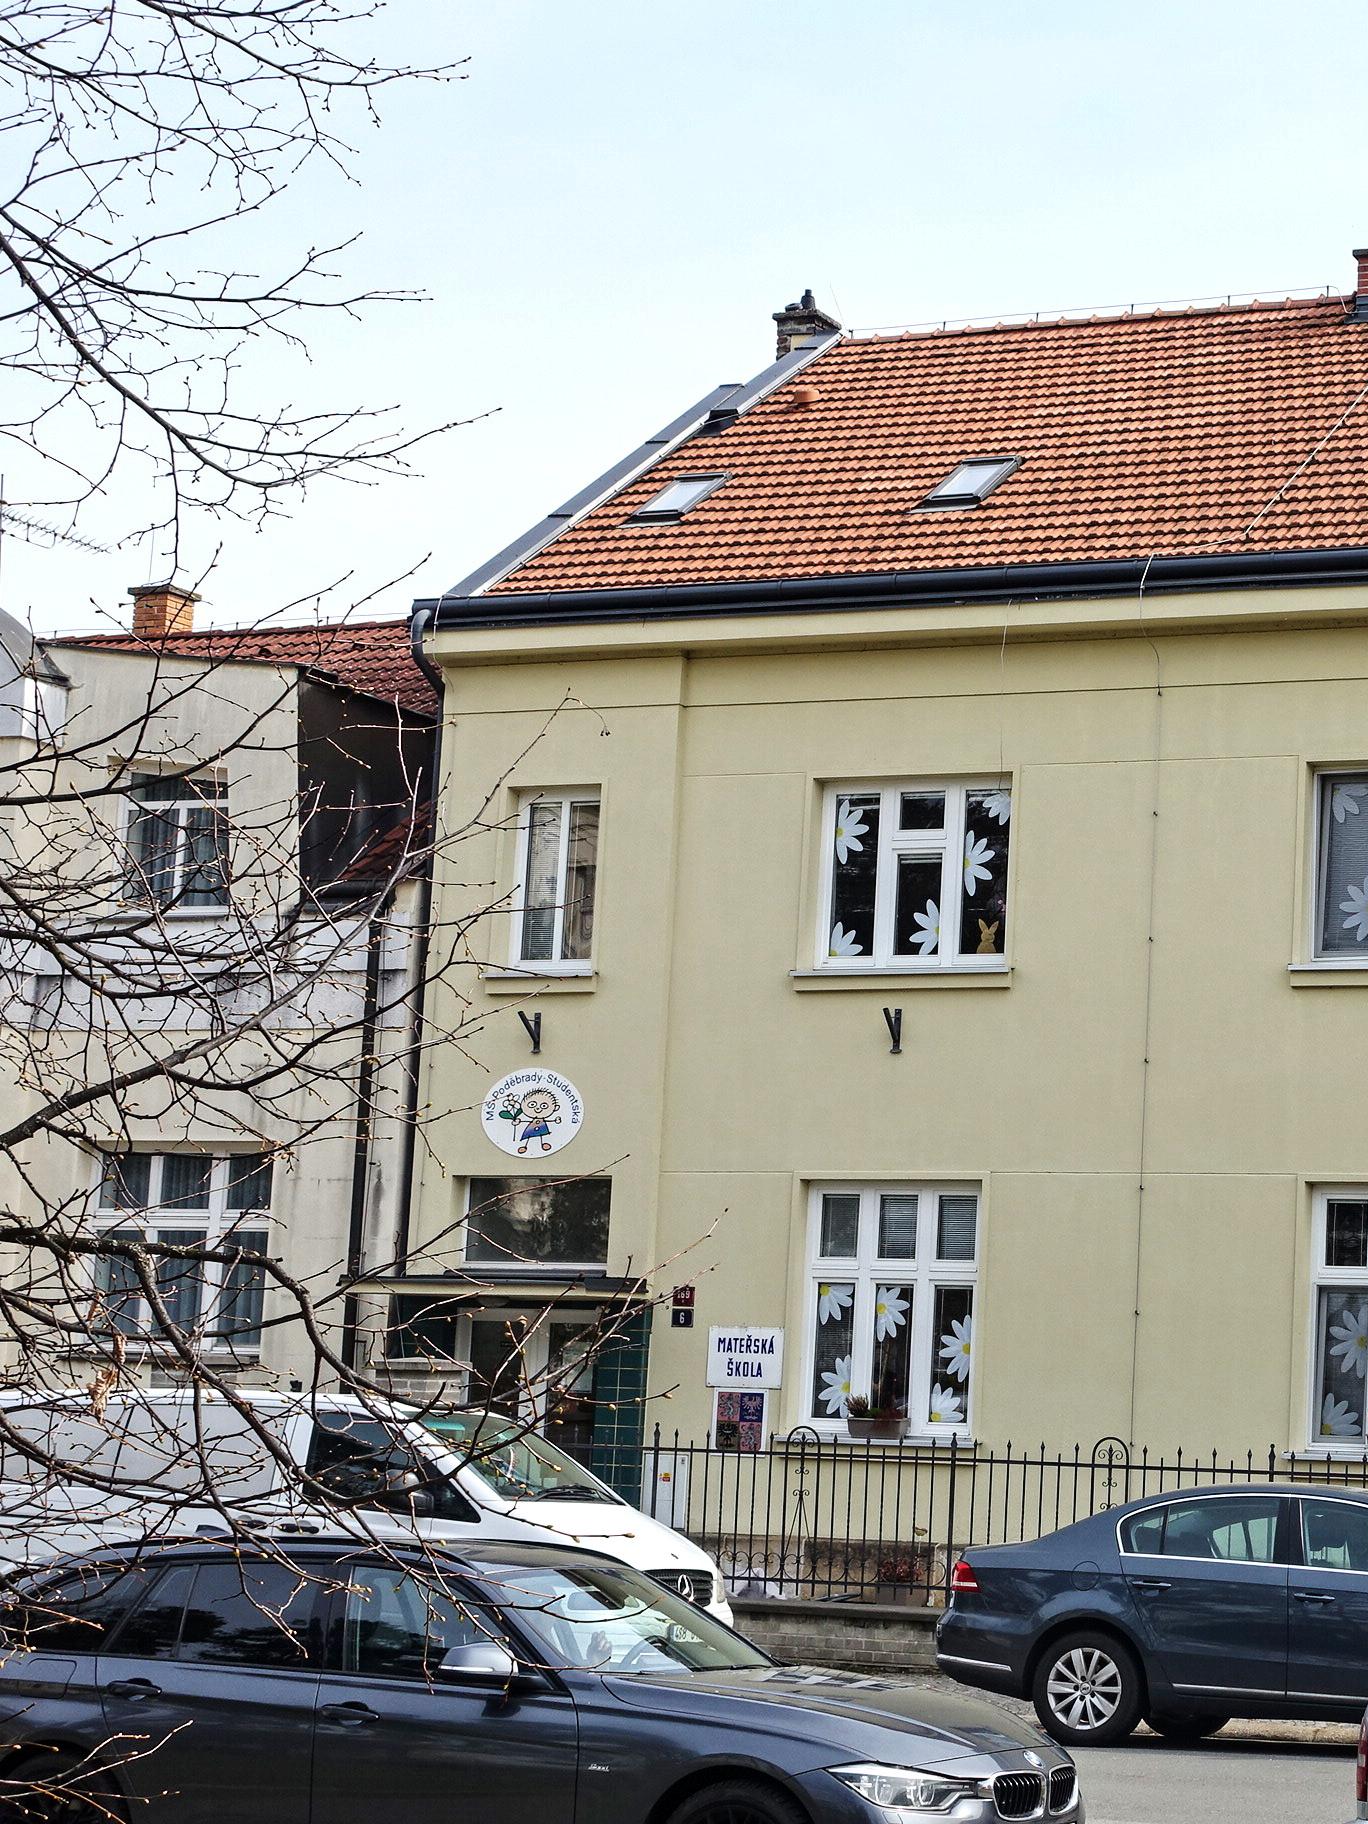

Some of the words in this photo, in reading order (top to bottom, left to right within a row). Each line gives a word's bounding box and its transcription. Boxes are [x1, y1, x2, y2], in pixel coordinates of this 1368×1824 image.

[679, 1312, 685, 1324] 6
[717, 1334, 775, 1355] MATEŘSKÁ
[726, 1357, 763, 1378] ŠKOLA
